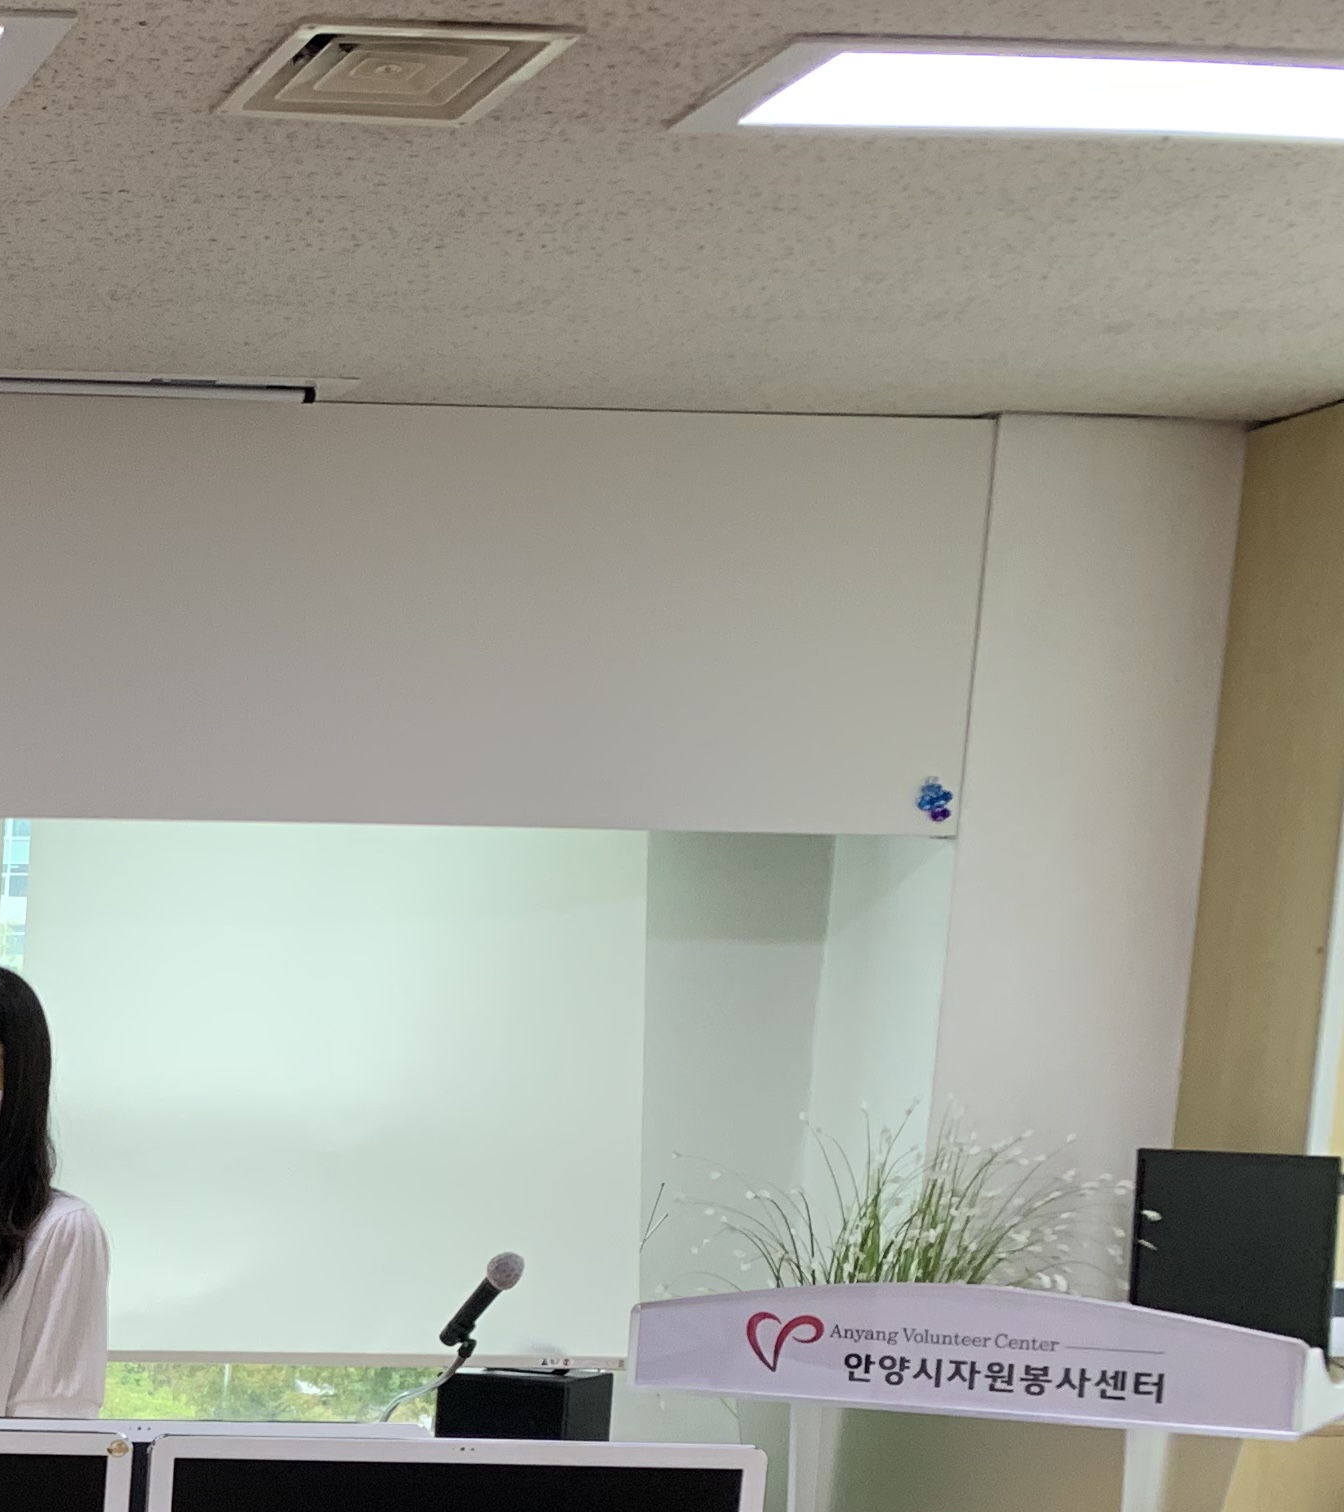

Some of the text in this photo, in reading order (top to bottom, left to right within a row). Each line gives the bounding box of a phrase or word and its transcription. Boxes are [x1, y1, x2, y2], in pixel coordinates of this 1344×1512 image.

[829, 1323, 1060, 1352] Anyang Volunteer Center
[843, 1352, 1165, 1404] 안양시자원봉사센터
